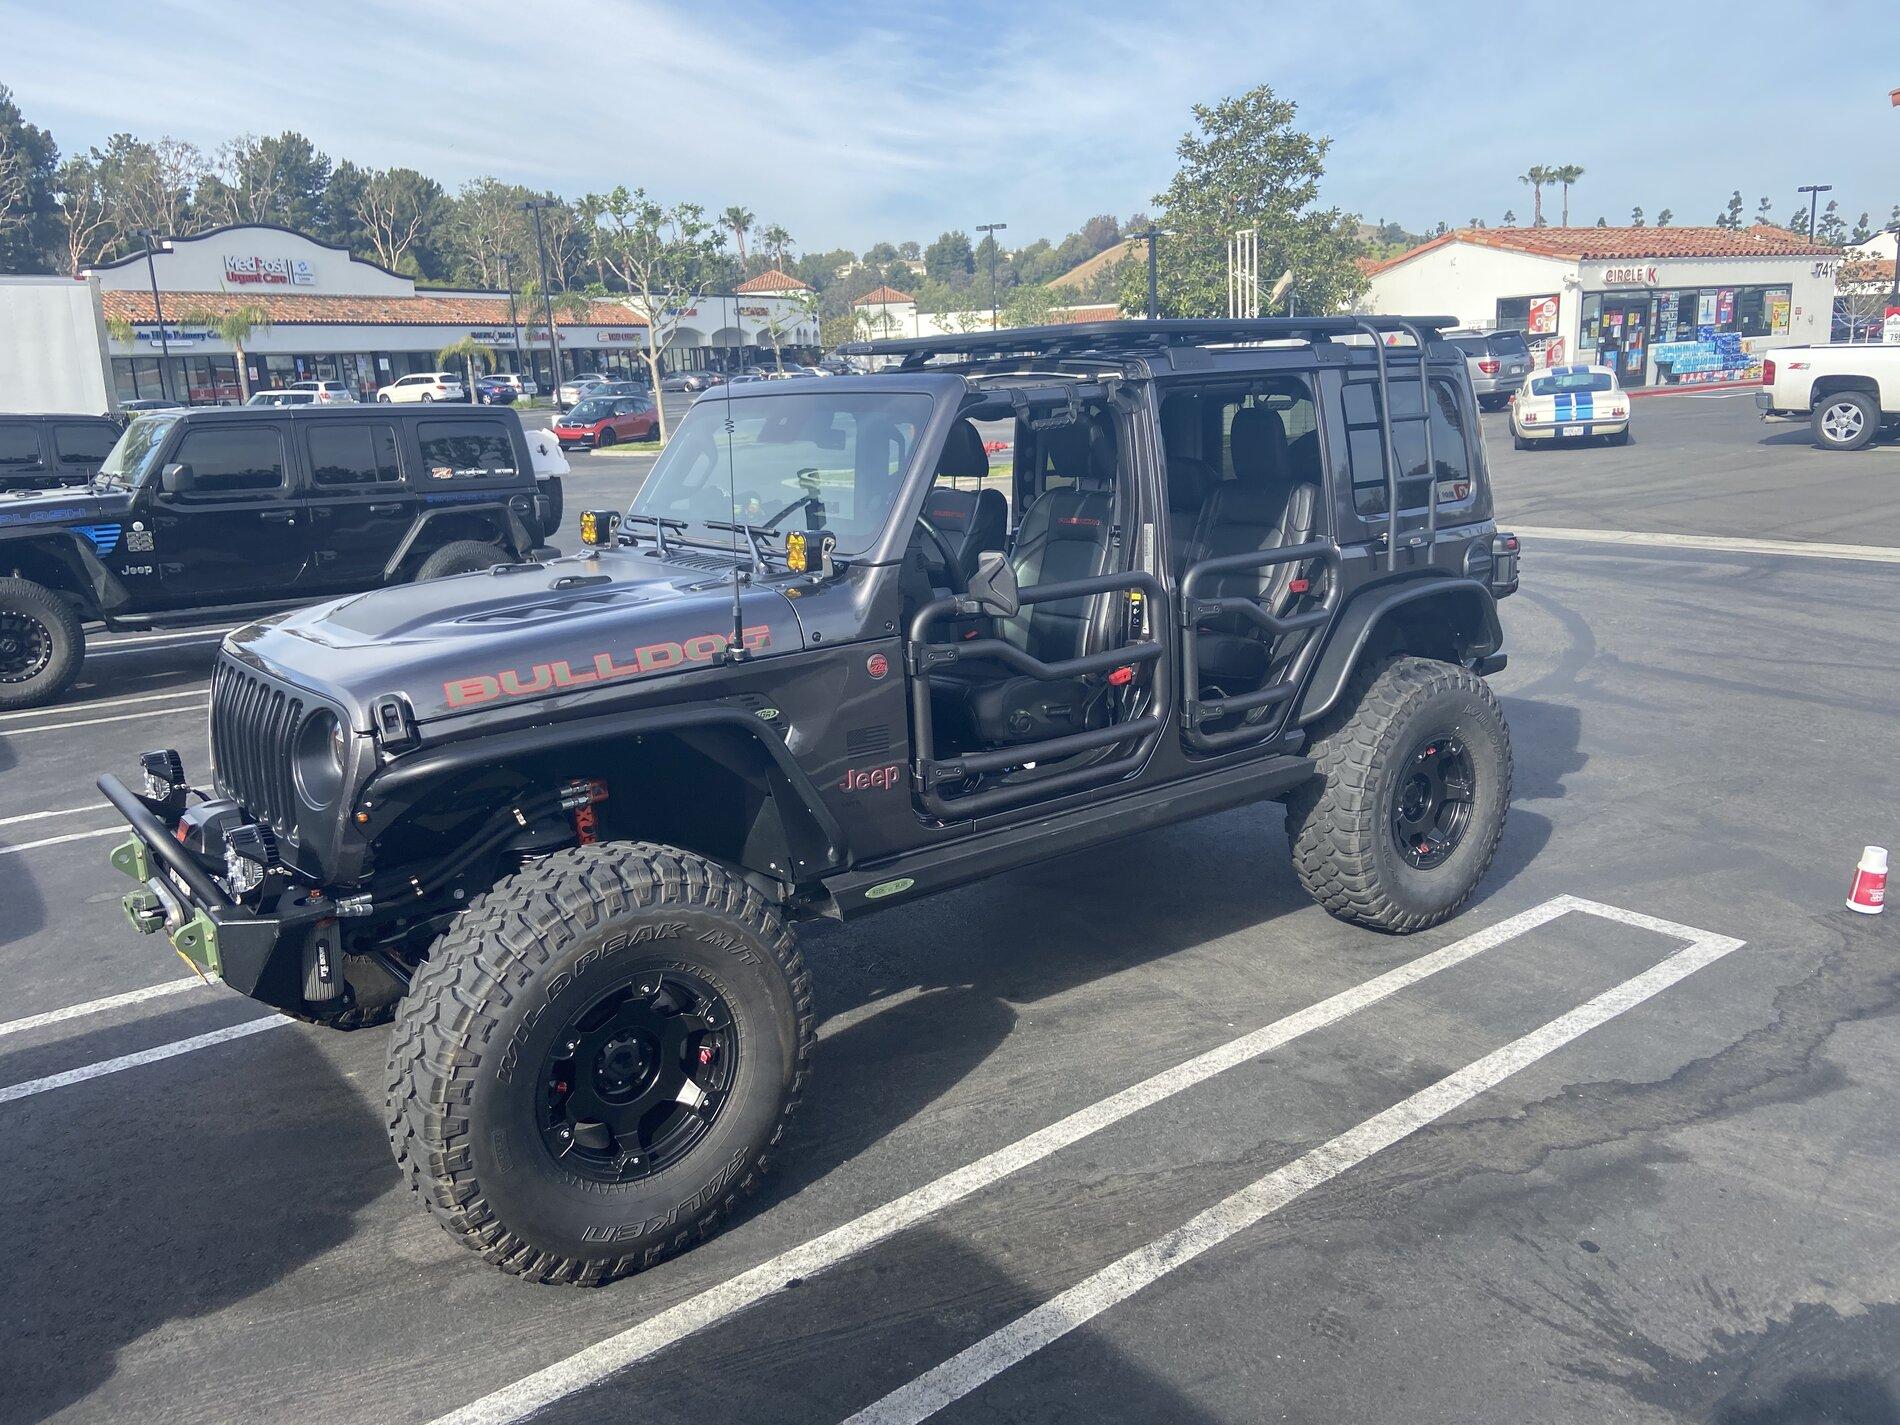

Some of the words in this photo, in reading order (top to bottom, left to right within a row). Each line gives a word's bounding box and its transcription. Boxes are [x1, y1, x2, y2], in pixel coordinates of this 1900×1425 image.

[223, 255, 287, 273] MedPost
[1605, 269, 1643, 282] CIRCLE
[1648, 267, 1657, 283] K
[226, 271, 262, 284] Urgent
[263, 273, 287, 283] Care
[121, 564, 153, 575] Jeep
[443, 625, 772, 708] BULLDOG
[839, 765, 901, 793] Jeep
[497, 922, 688, 1085] WILDPEAK
[697, 929, 763, 966] M/T
[581, 1146, 749, 1243] FALKEN
